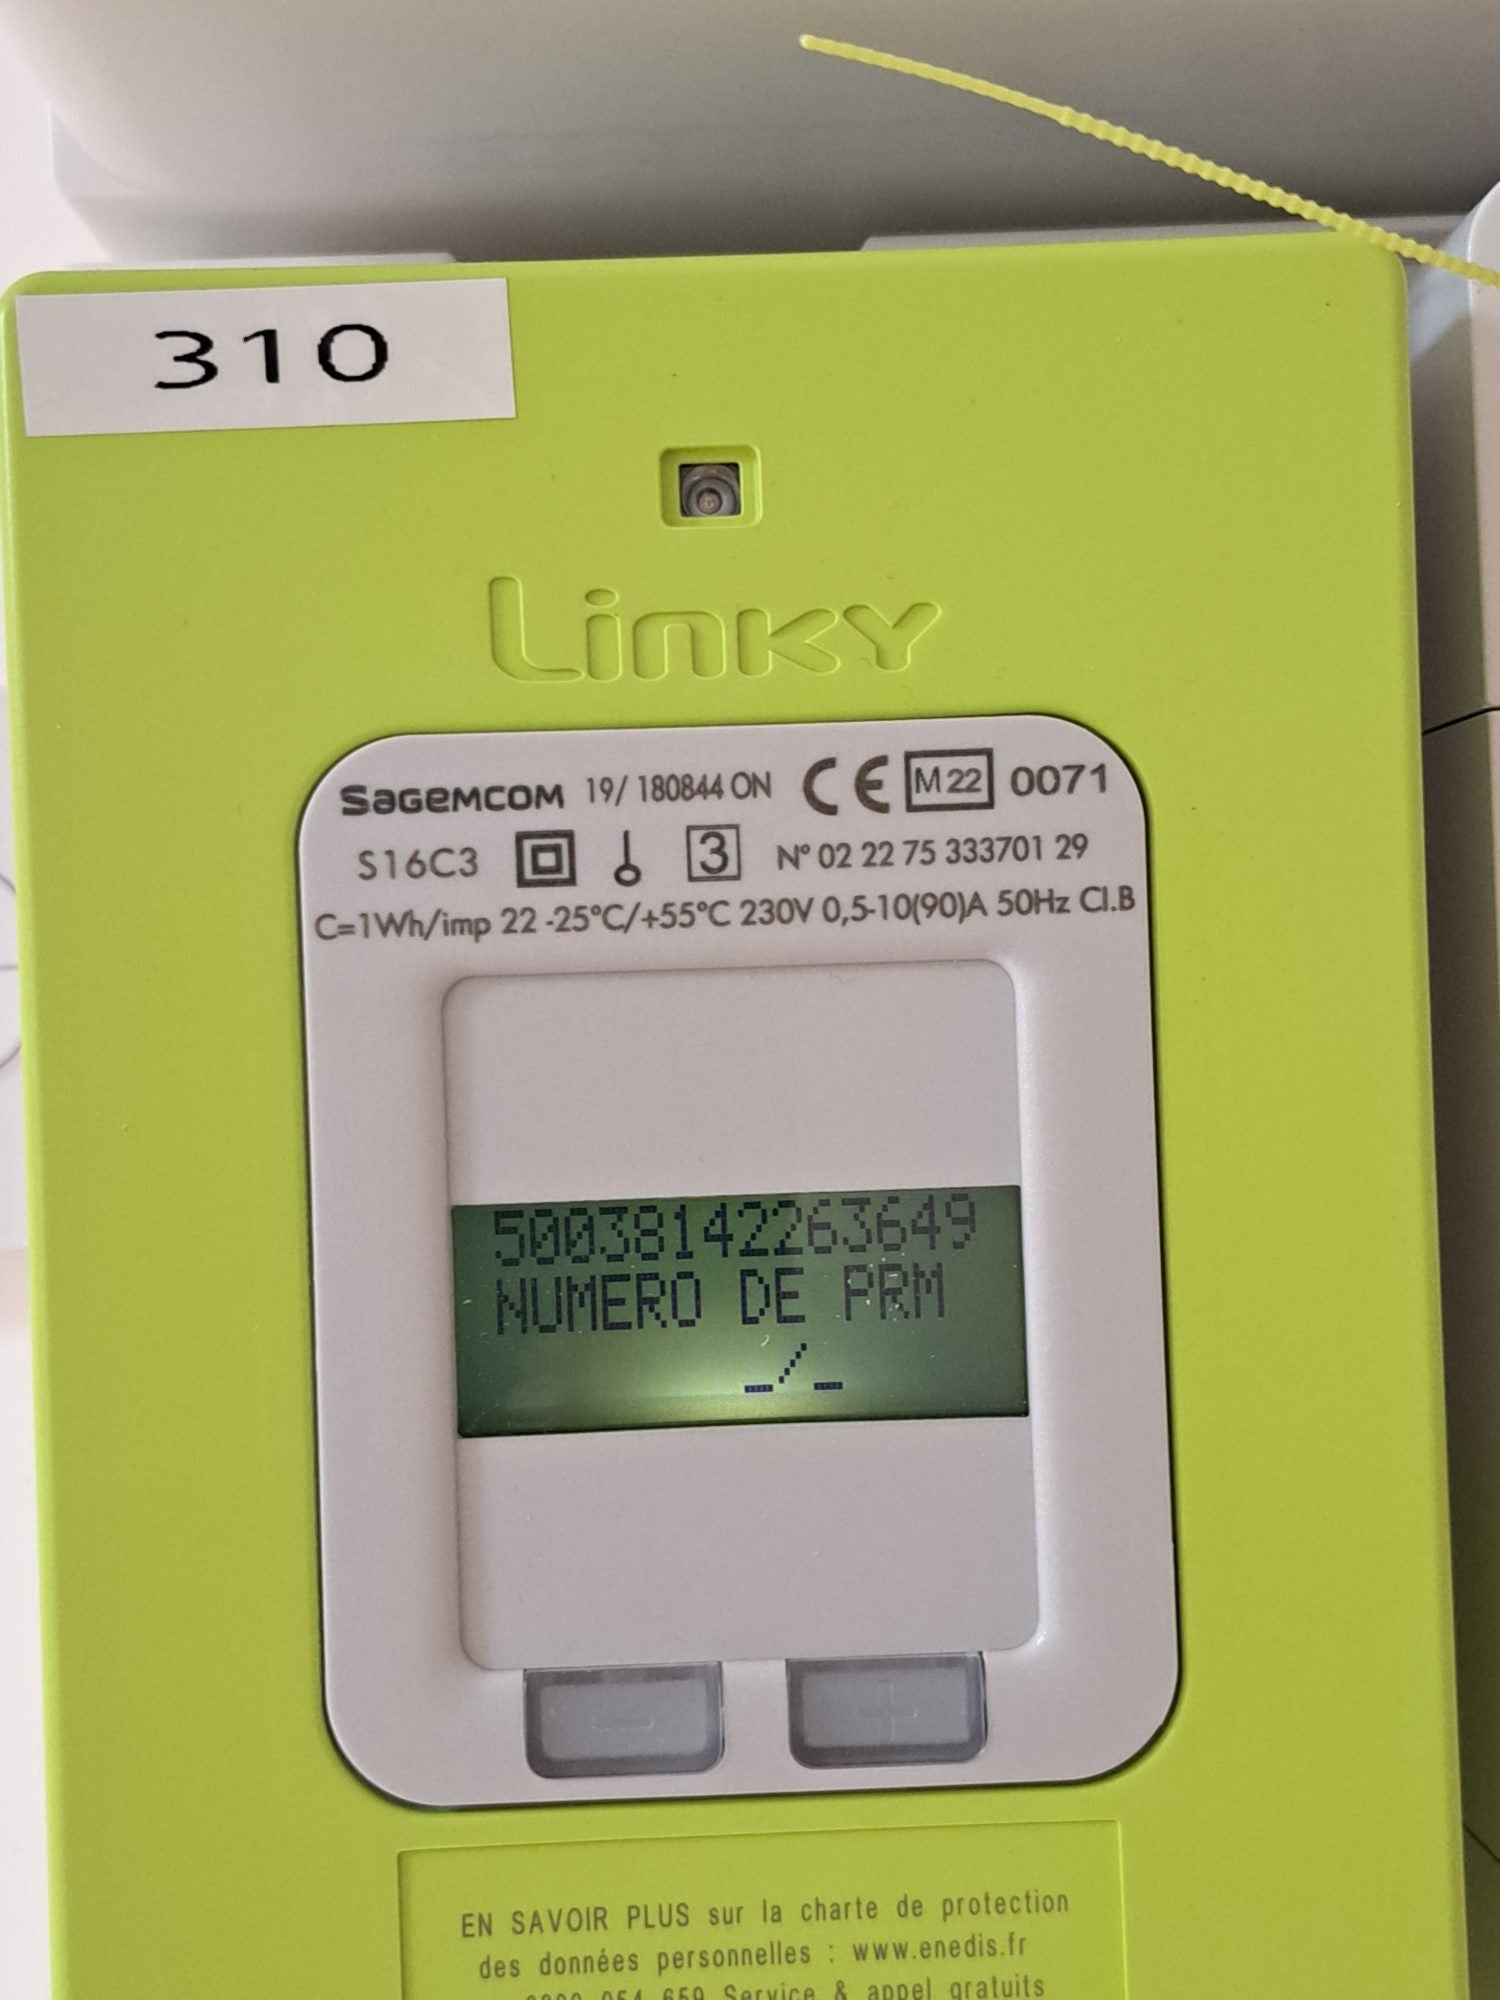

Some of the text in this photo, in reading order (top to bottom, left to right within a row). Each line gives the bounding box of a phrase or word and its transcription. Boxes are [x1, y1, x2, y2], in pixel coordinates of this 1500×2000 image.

[154, 323, 389, 390] 310
[638, 773, 725, 803] 180844
[730, 770, 772, 801] ON
[1010, 762, 1107, 797] 0071
[357, 846, 479, 881] S16C3
[699, 831, 730, 875] 3
[817, 842, 853, 870] 02
[860, 840, 895, 868] 22
[902, 839, 936, 866] 75
[945, 834, 1042, 865] 333701
[1055, 832, 1089, 860] 29
[314, 908, 492, 944] C=1Wh/imp
[500, 906, 538, 935] 22
[739, 896, 815, 927] 230V
[821, 890, 989, 927] 0,5-10(90)A
[996, 887, 1071, 917] 50Hz
[493, 1193, 977, 1267] 50038142263649
[494, 1261, 946, 1336] NUMERO DE PRM
[461, 1888, 1069, 1939] EN SAVOIR PLUS sur la charte de protection
[479, 1954, 521, 1980] des
[539, 1948, 639, 1977] données
[657, 1940, 811, 1977] personnelles
[852, 1931, 1027, 1962] www.enedis.fr
[949, 1973, 1045, 2000] gratuits
